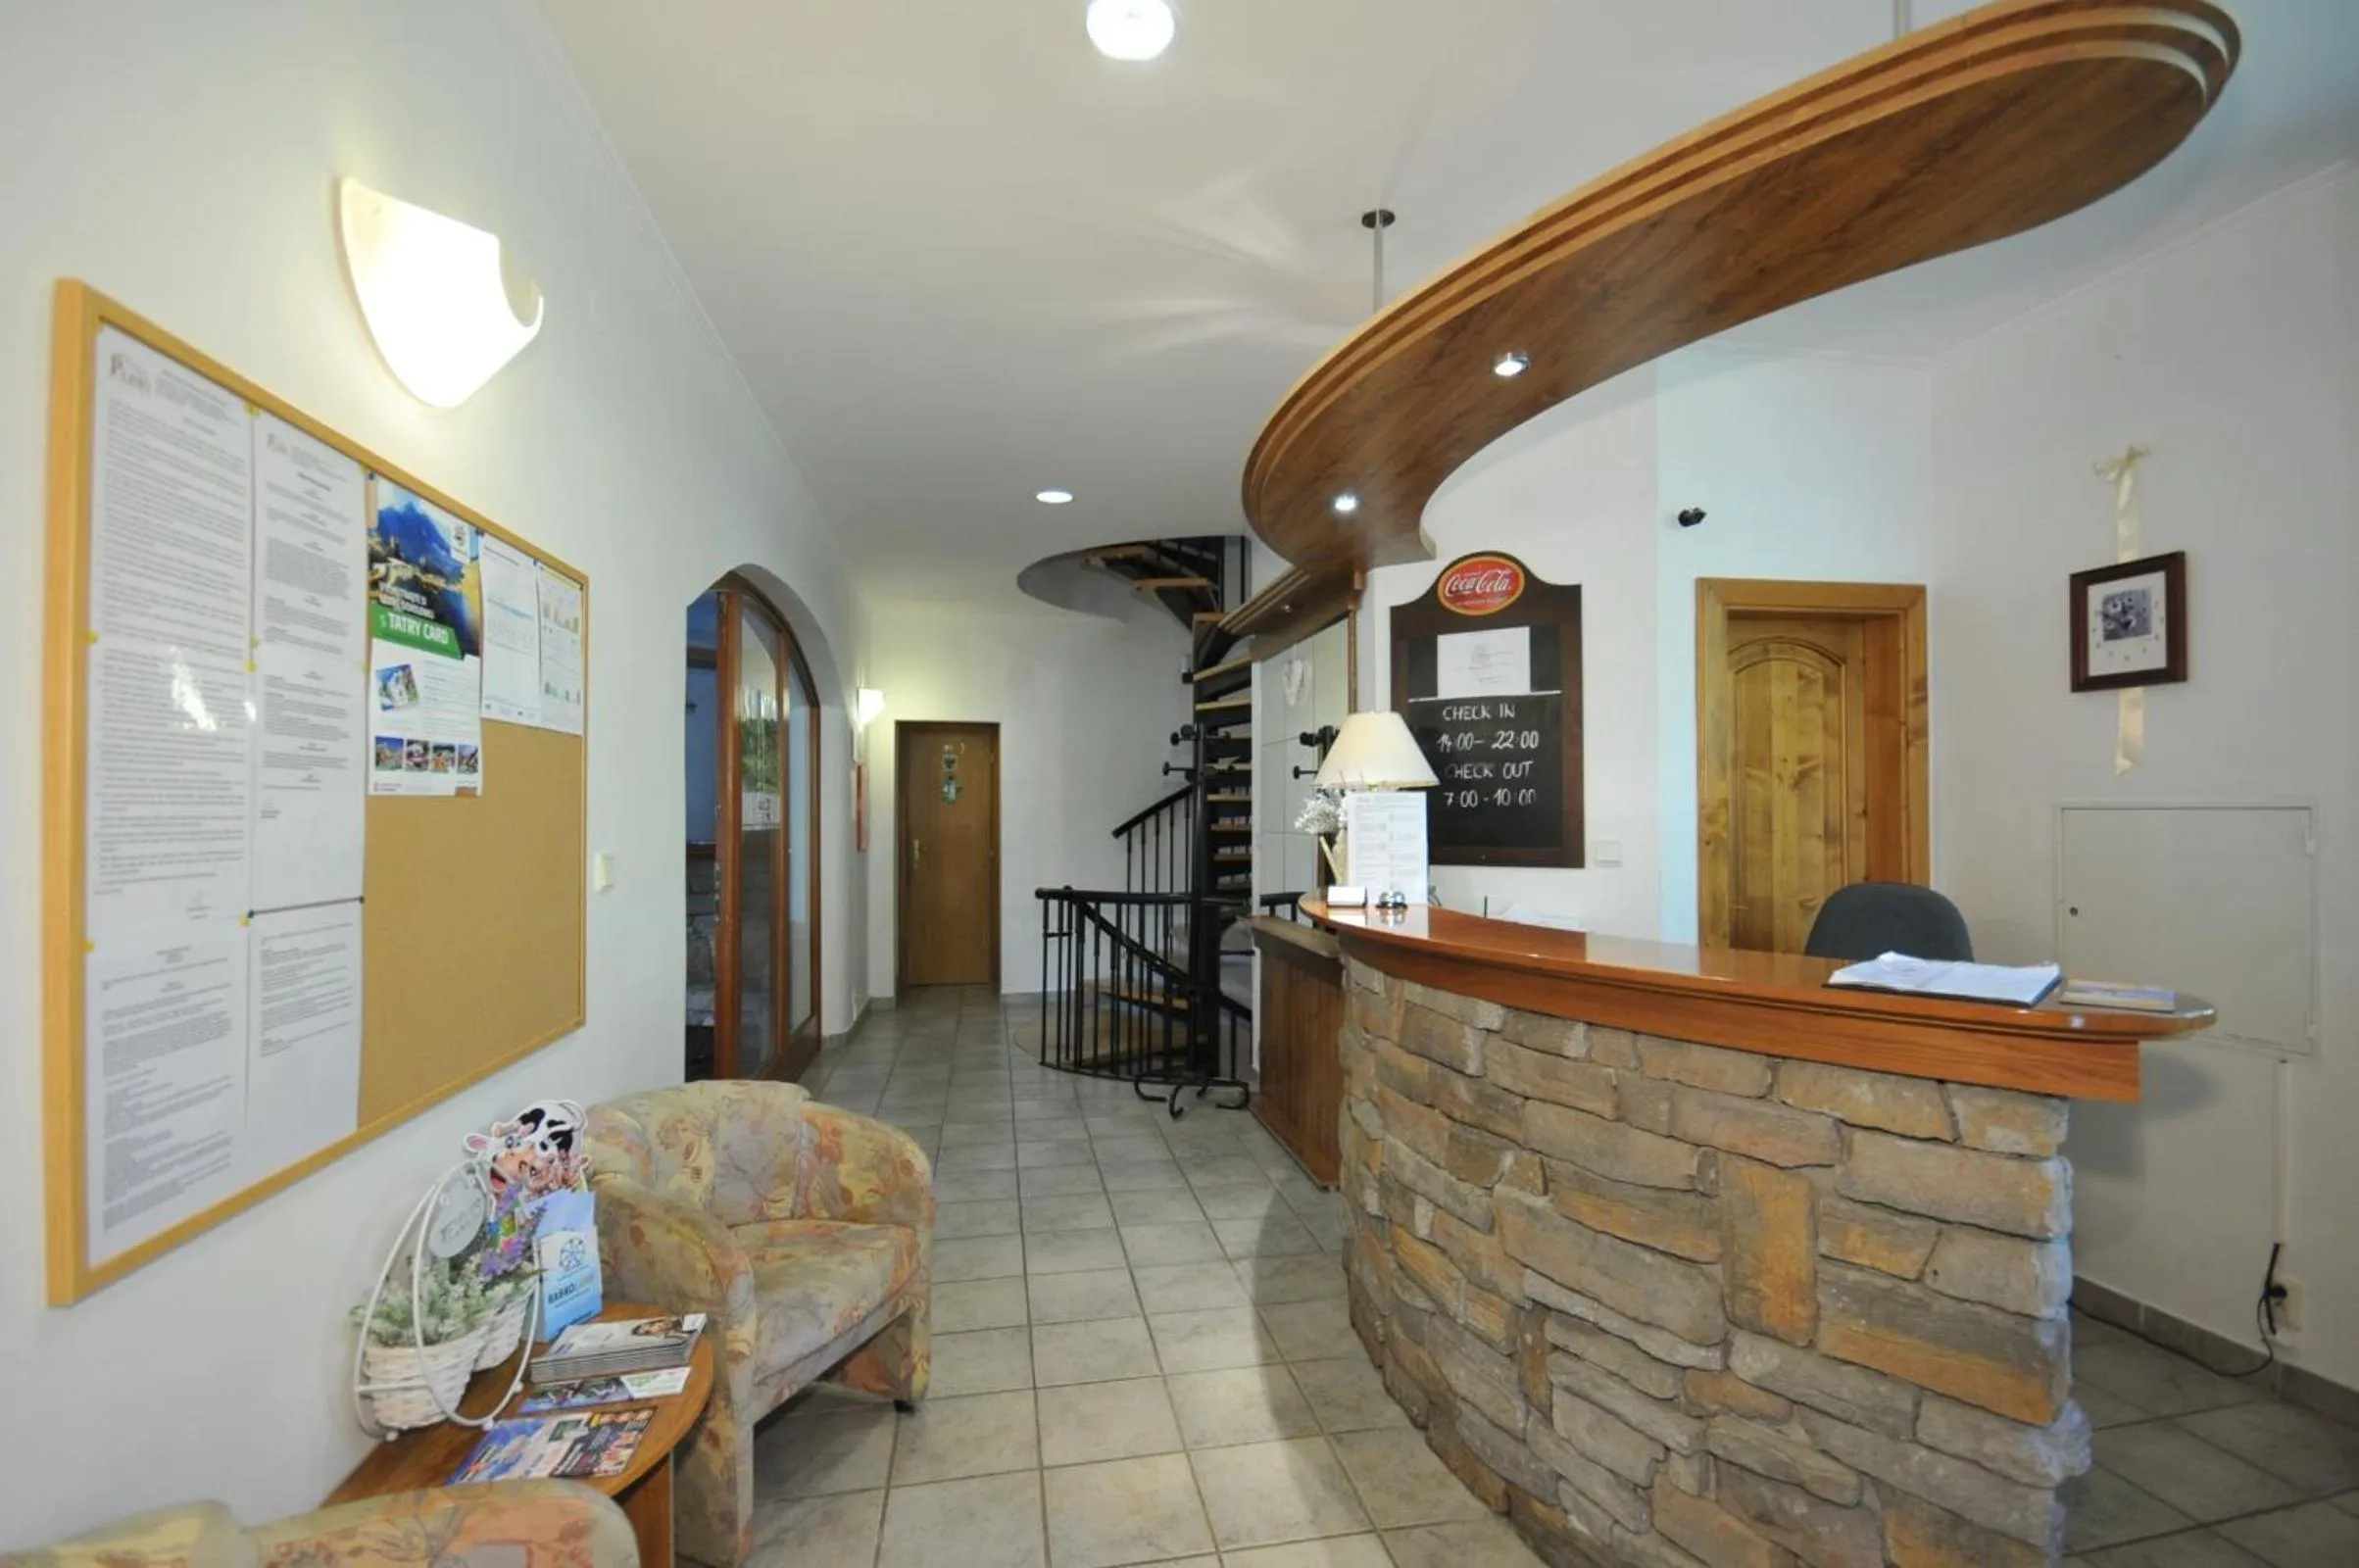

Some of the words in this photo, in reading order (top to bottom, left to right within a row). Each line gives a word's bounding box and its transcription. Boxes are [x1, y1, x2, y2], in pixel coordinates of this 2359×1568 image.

[1443, 704, 1492, 721] CHECK
[1499, 703, 1516, 718] IN
[1445, 762, 1494, 780] CHECK
[1502, 760, 1535, 779] OUT
